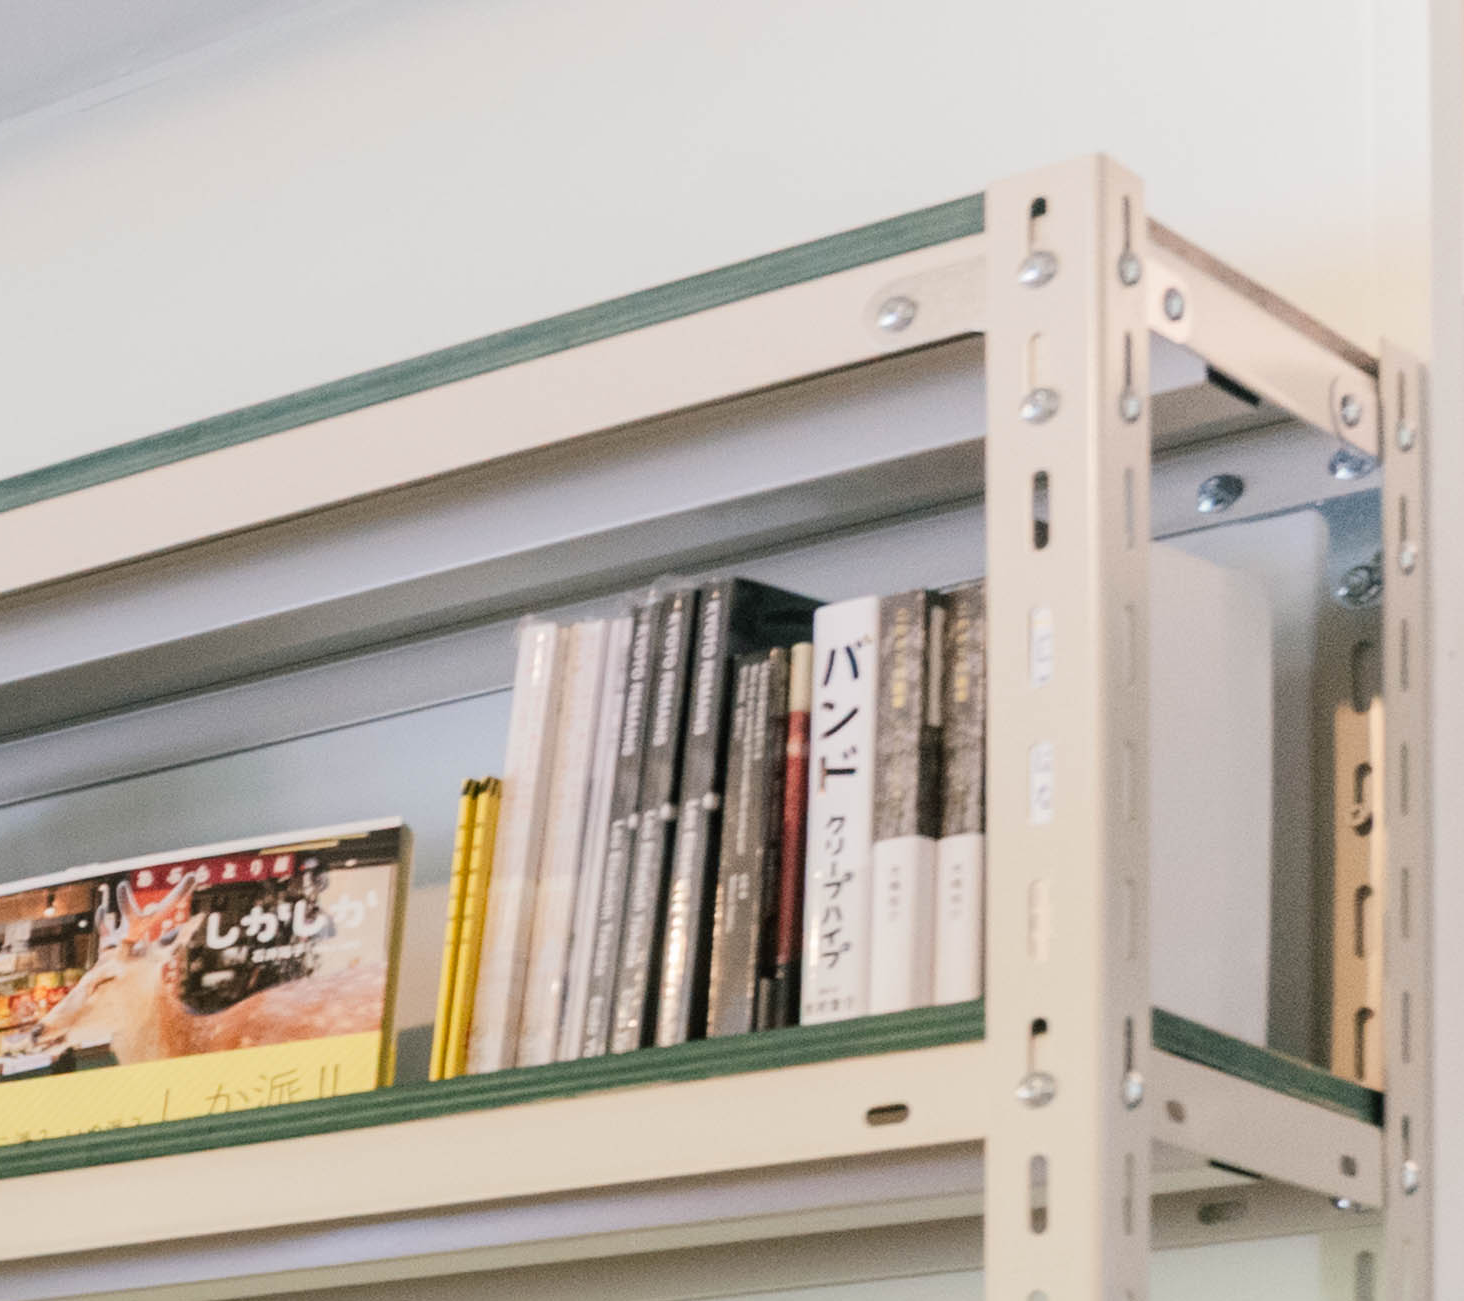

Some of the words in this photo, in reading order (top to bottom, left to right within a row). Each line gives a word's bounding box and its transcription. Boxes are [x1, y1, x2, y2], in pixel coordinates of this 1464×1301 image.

[818, 636, 873, 796] バンド
[820, 812, 853, 972] クリープハイプ
